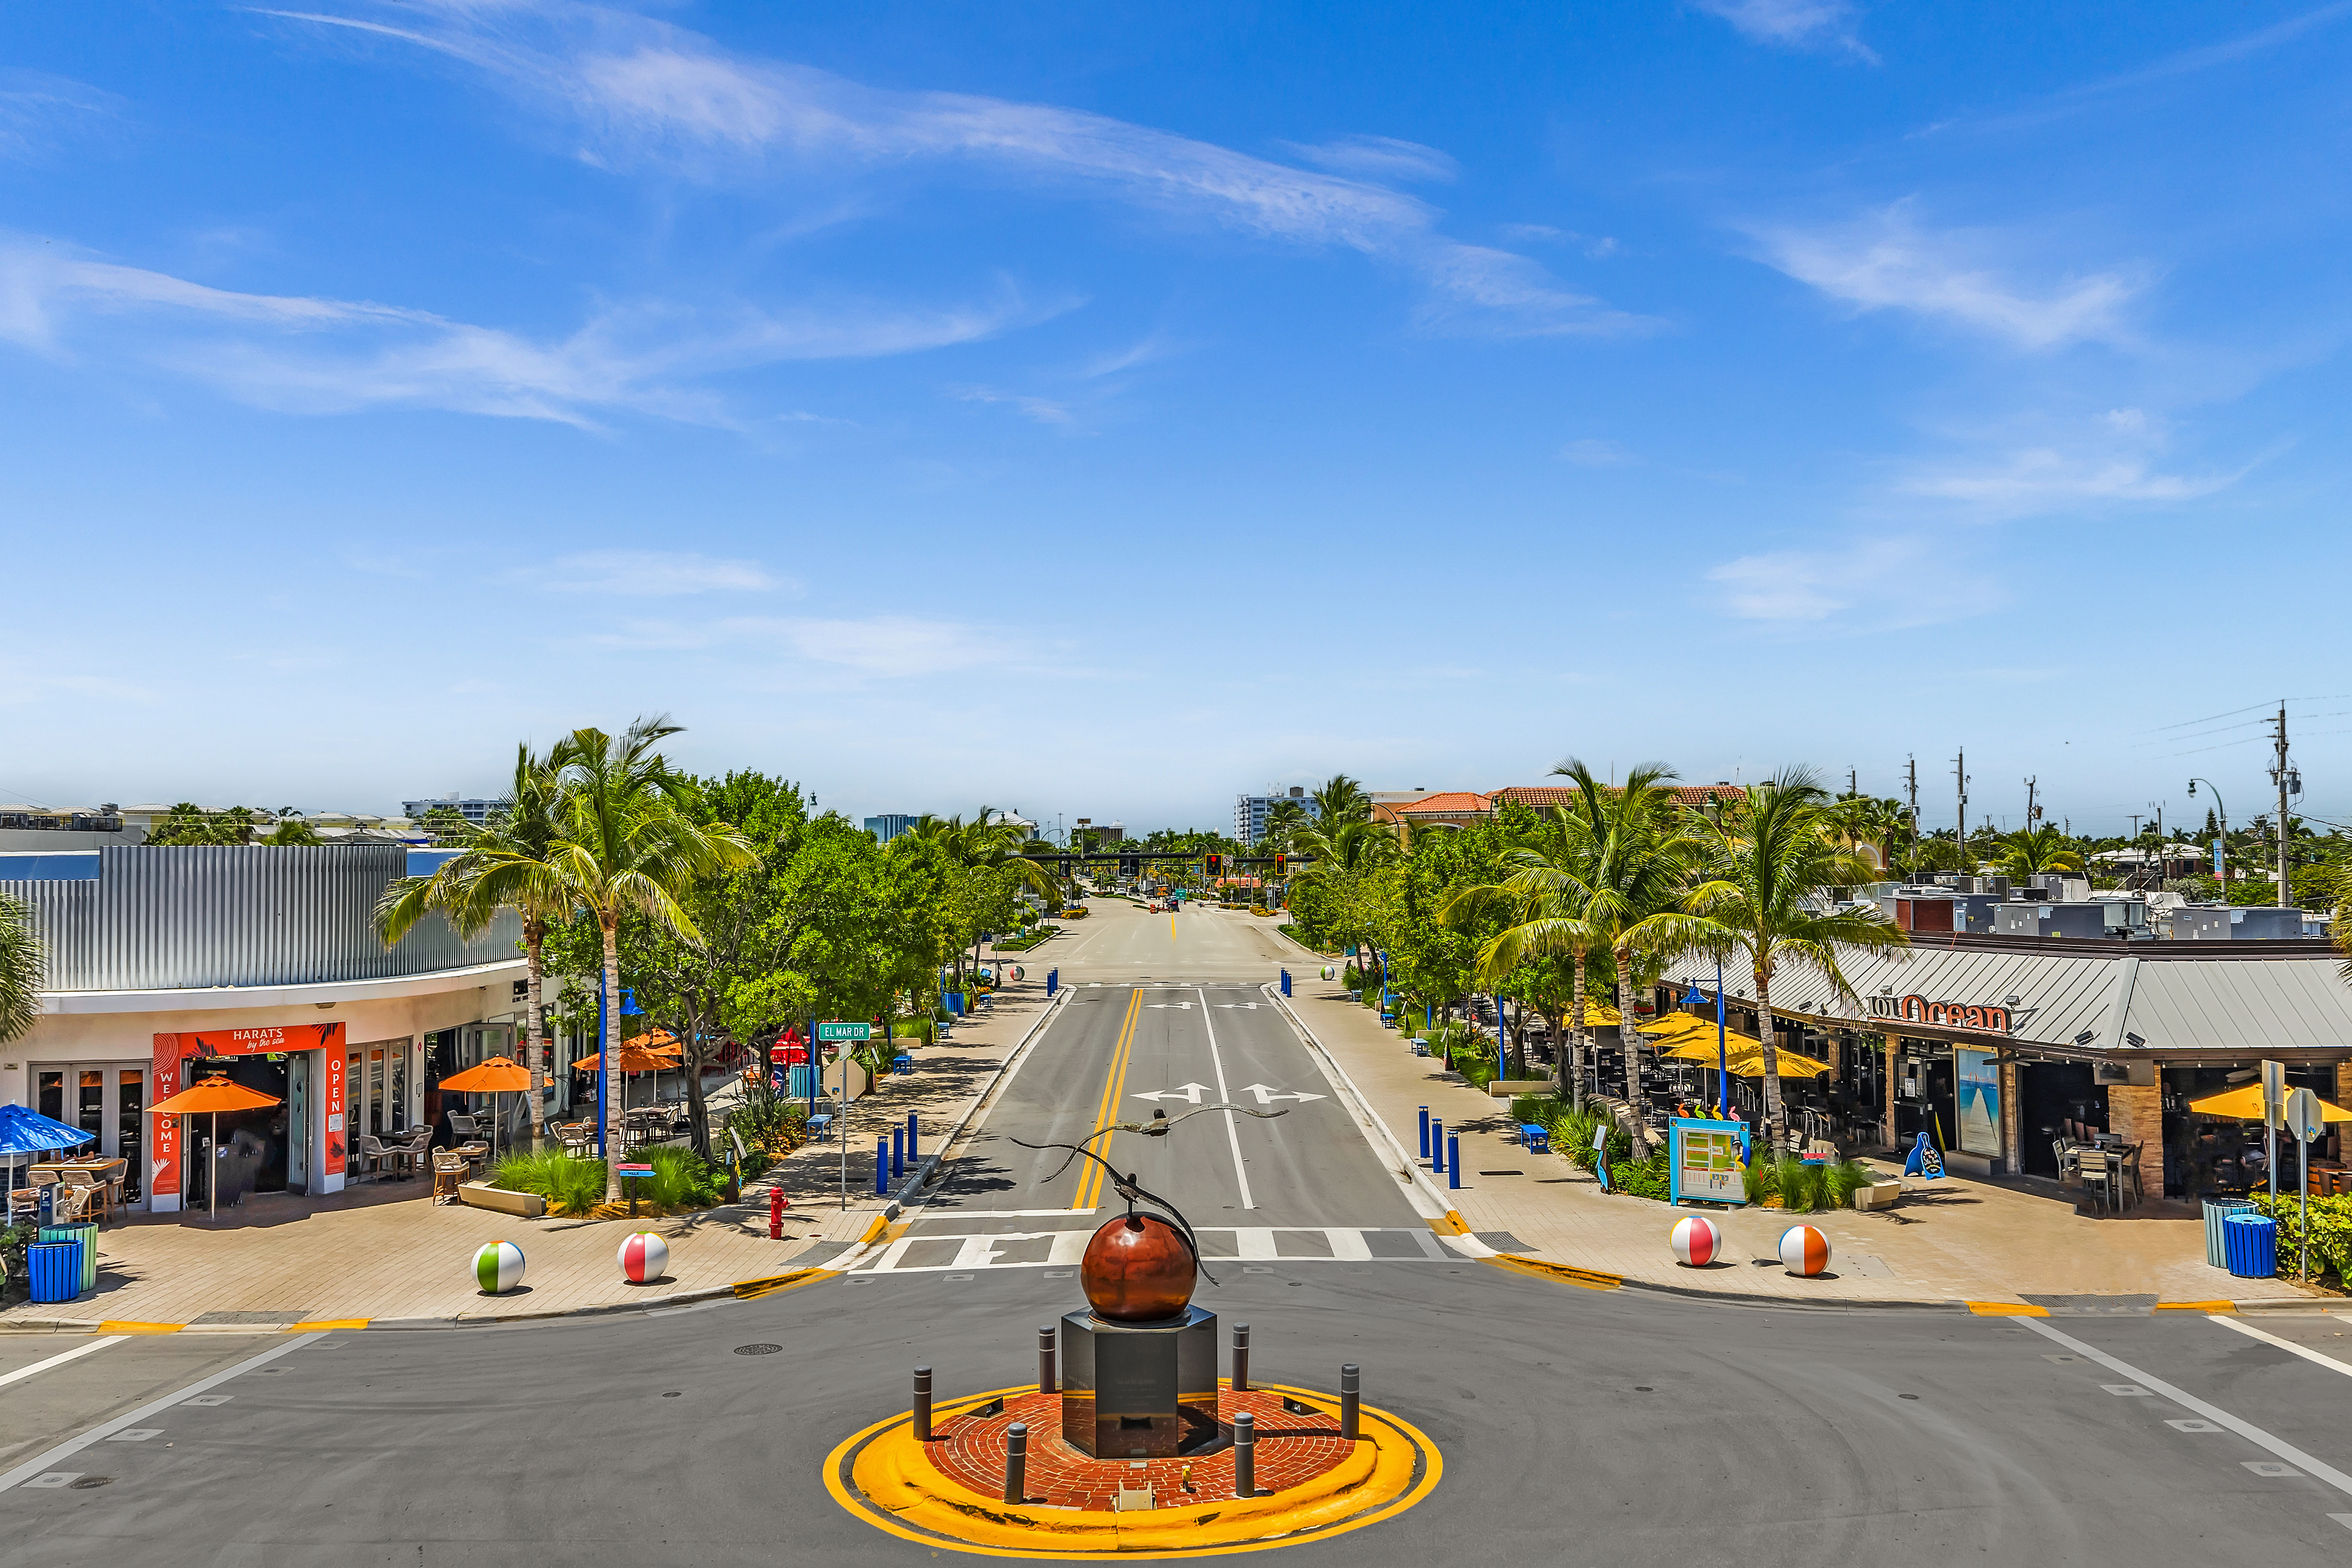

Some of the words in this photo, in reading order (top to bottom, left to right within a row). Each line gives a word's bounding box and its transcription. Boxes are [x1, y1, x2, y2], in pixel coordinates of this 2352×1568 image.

[1865, 996, 1899, 1018] 101
[1901, 994, 2012, 1032] Ocean
[234, 1028, 283, 1040] HARAT'S
[825, 1027, 834, 1037] EL
[836, 1027, 852, 1037] MAR
[854, 1027, 864, 1037] DR
[247, 1040, 257, 1052] by
[259, 1038, 270, 1047] the
[331, 1060, 341, 1112] OPEN
[42, 1191, 50, 1200] P
